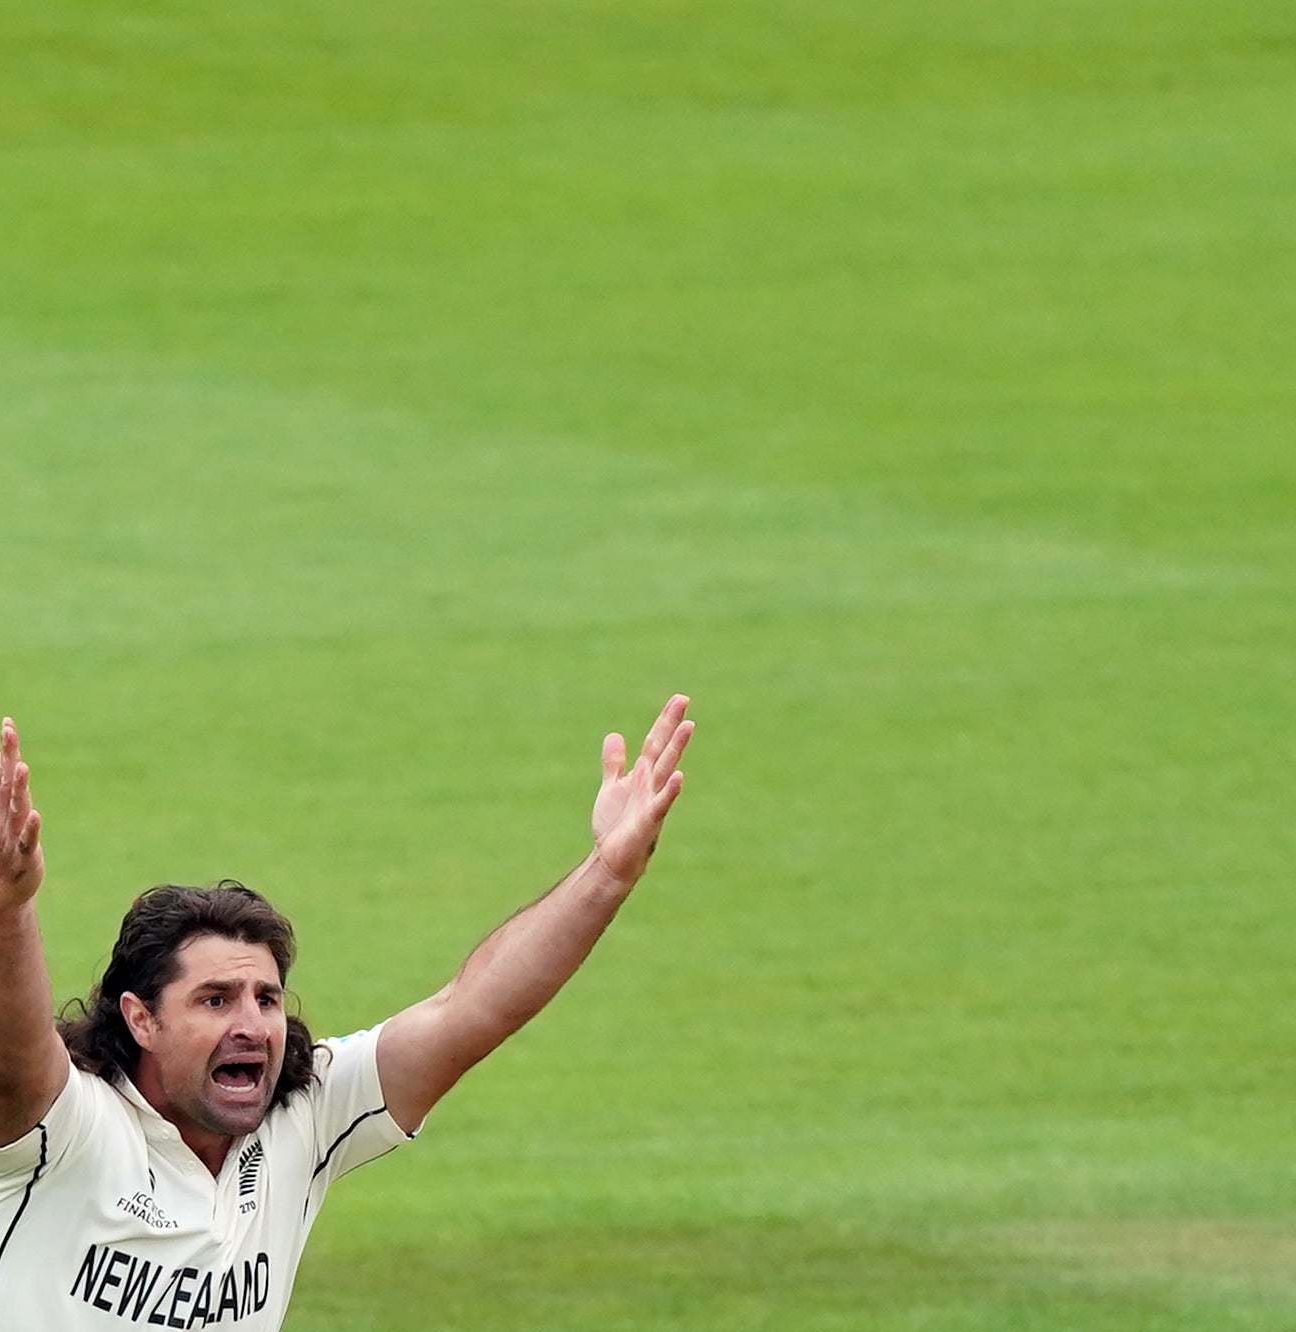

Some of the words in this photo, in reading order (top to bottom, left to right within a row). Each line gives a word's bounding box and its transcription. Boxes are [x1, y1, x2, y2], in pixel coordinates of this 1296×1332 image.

[116, 1197, 152, 1224] FINAL
[239, 1200, 257, 1214] 270
[70, 1244, 164, 1323] NEW
